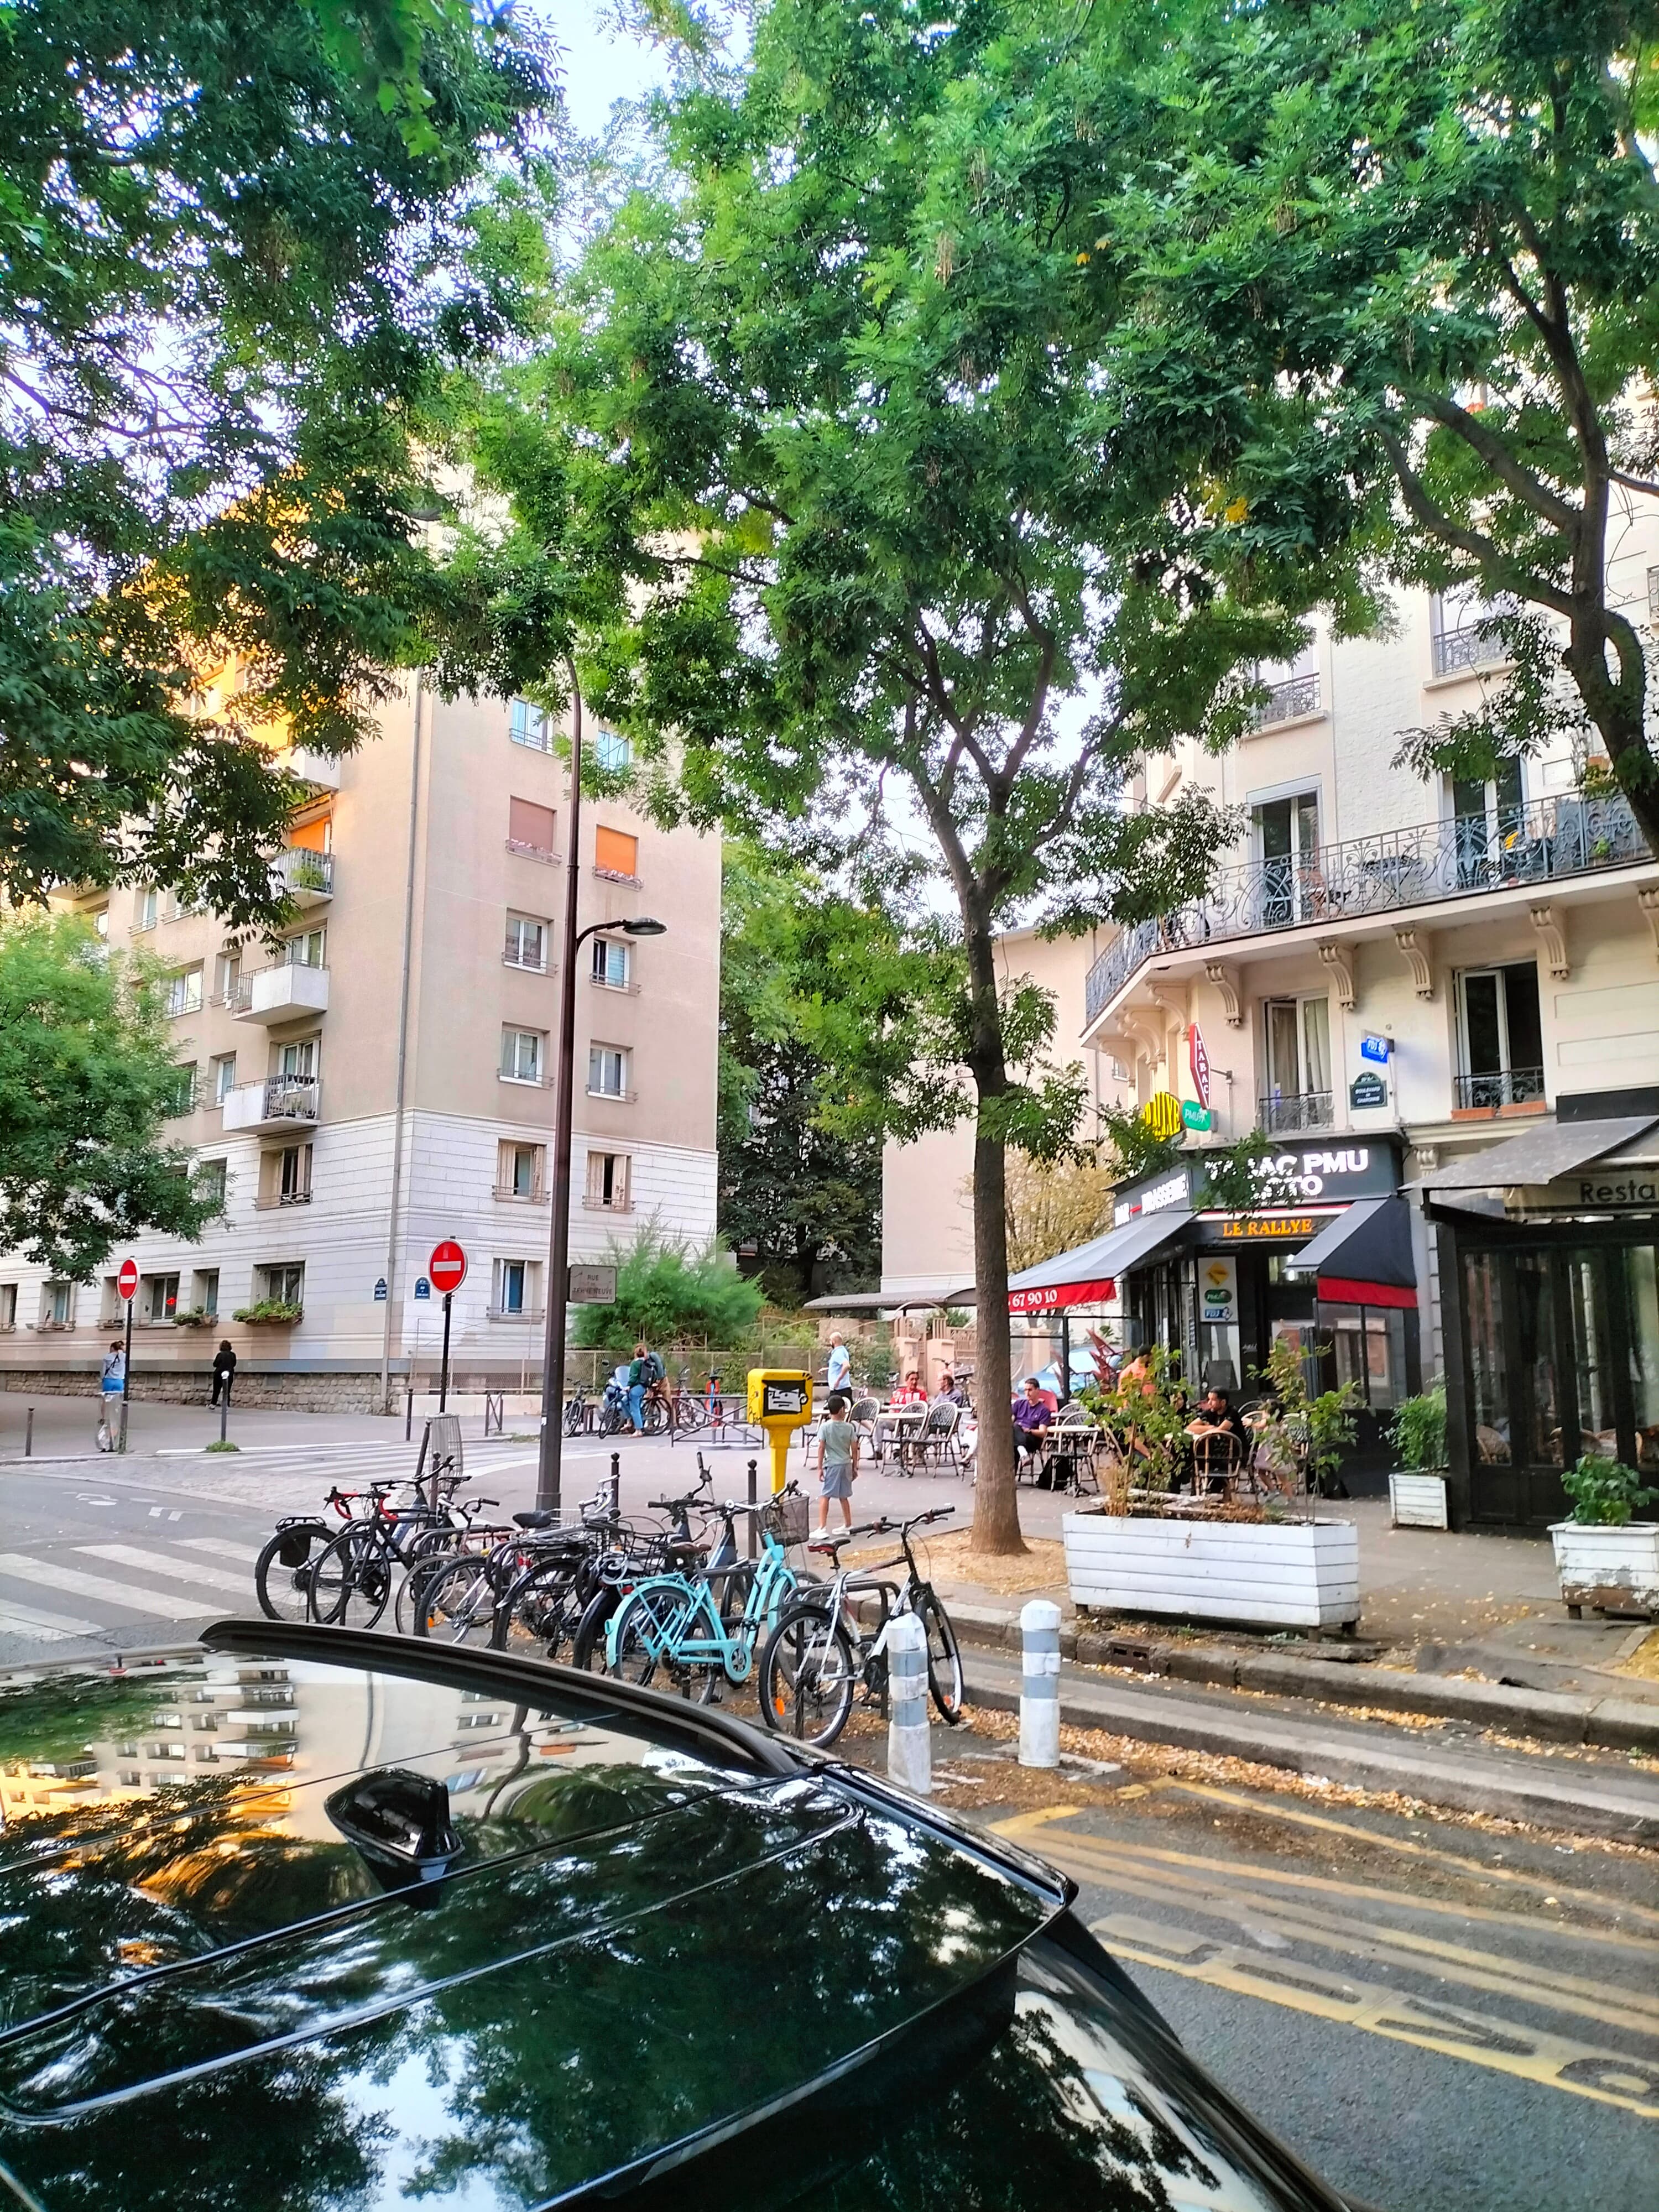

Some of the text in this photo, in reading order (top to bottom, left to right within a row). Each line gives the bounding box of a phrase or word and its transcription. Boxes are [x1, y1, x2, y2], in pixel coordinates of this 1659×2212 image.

[1197, 1040, 1208, 1094] TABAC
[1185, 1108, 1200, 1122] PMU
[1303, 1149, 1369, 1175] PMU
[1580, 1179, 1656, 1203] Resta
[1223, 1218, 1313, 1237] LE RALLYE
[1012, 1290, 1057, 1307] 67 90 10
